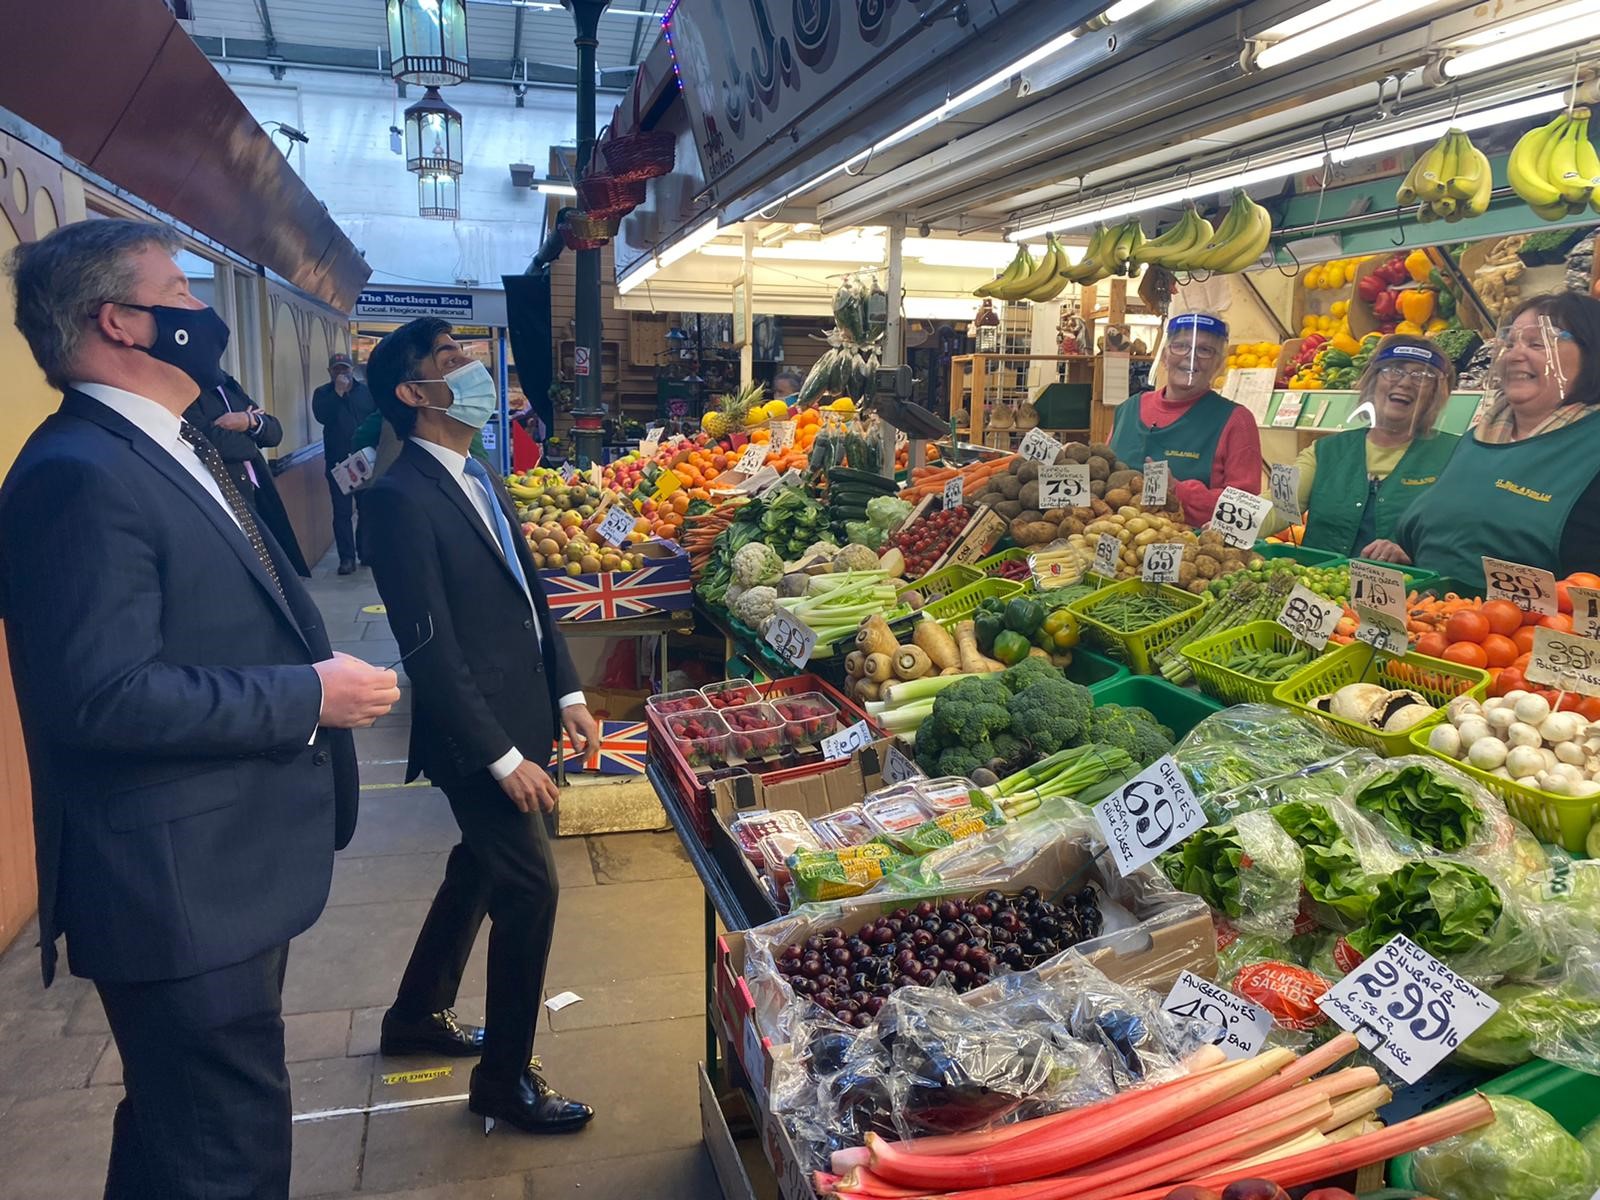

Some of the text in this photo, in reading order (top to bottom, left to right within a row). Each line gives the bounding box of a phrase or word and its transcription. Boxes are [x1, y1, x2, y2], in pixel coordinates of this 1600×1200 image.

[360, 293, 469, 306] The Northern Echo
[362, 305, 467, 316] Local. Regional. National.
[1045, 478, 1082, 496] 79
[1215, 502, 1252, 531] 89
[1097, 542, 1112, 562] 89
[1147, 550, 1174, 571] 69
[1490, 571, 1542, 600] 89
[1285, 597, 1323, 632] 89
[775, 618, 806, 659] 99
[1547, 641, 1592, 670] 39
[1160, 762, 1196, 823] CHERRIES
[1122, 781, 1175, 849] 69
[1393, 935, 1426, 962] NEW
[1182, 974, 1256, 1022] AUBERGINES
[1250, 976, 1311, 1010] SALADS
[410, 1070, 446, 1080] DISTANCE
